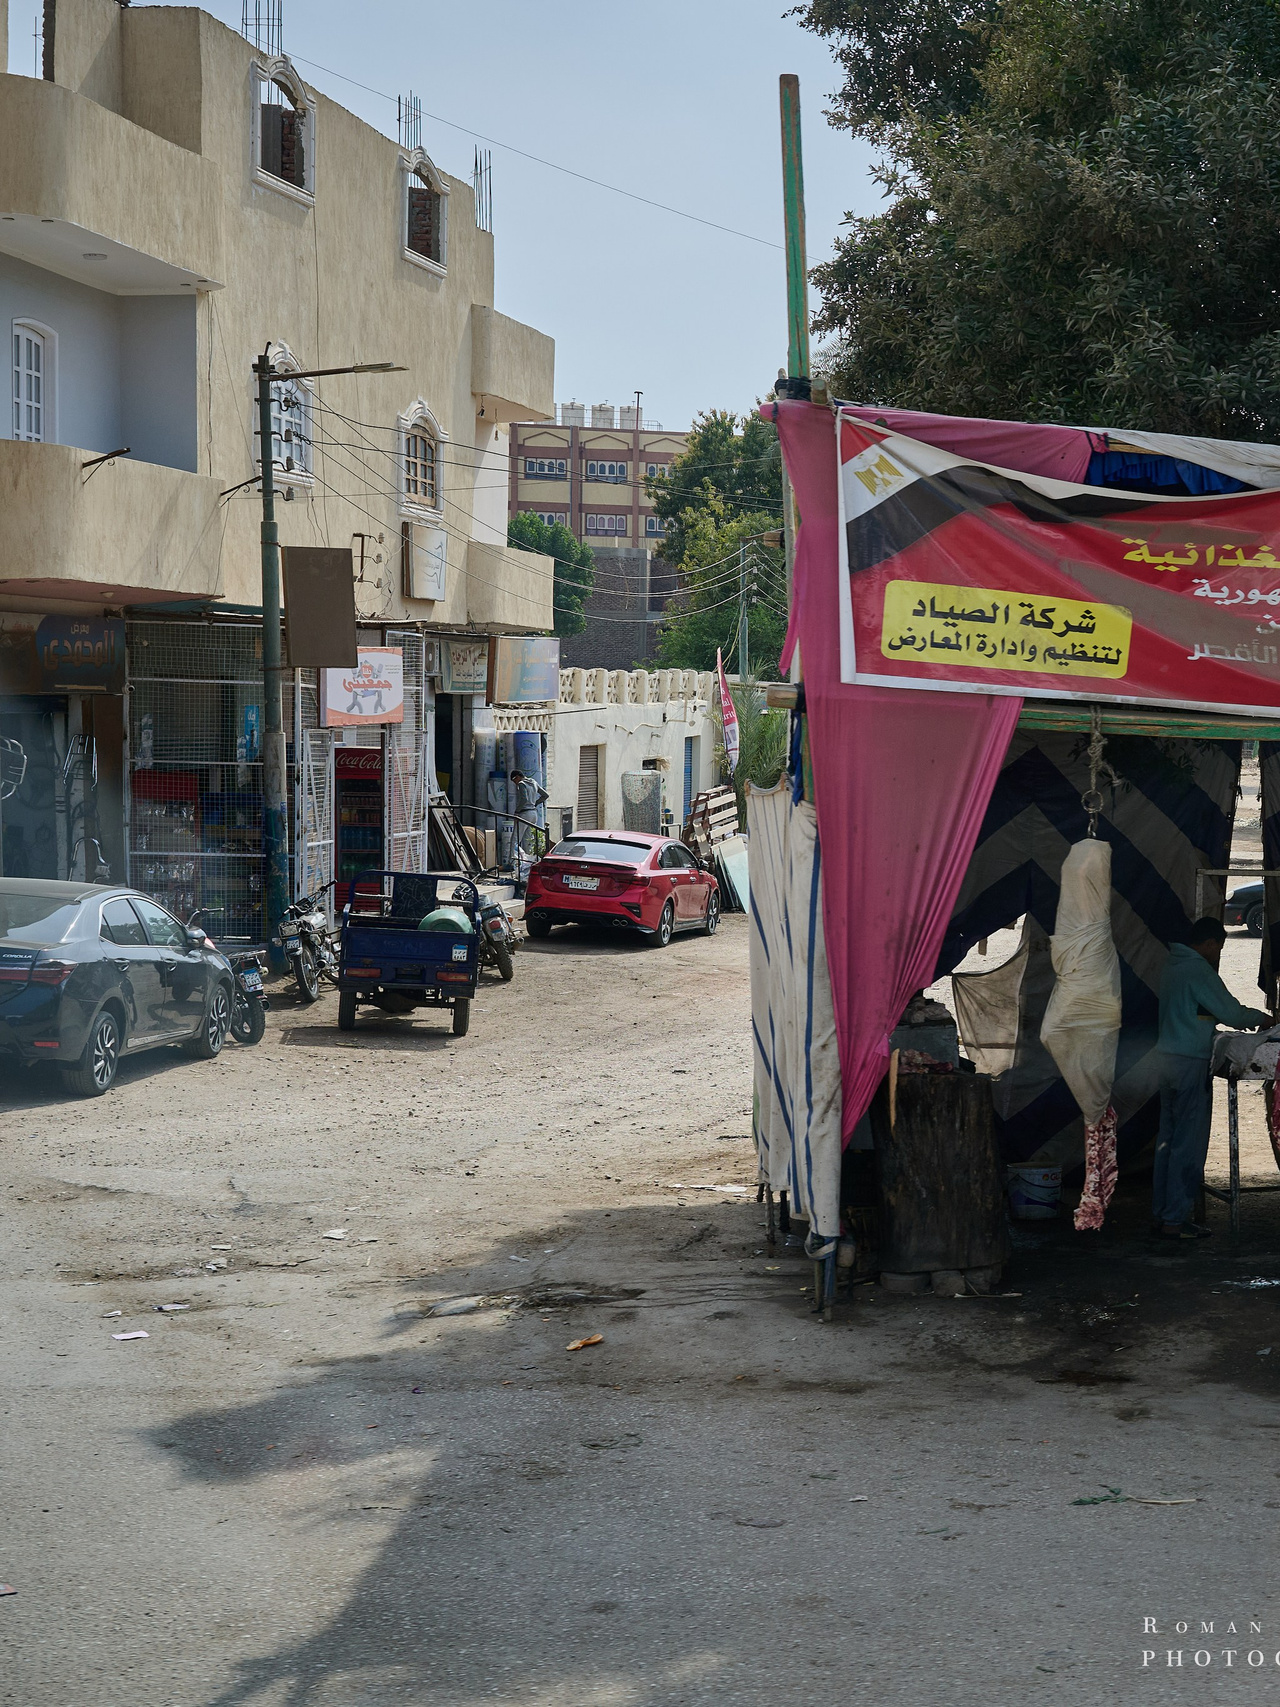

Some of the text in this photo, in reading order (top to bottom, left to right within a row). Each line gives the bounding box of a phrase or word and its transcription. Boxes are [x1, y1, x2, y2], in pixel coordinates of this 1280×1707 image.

[912, 596, 1096, 638] شركة الصياد
[888, 627, 1122, 667] لتنظيم وادارة المعارض
[1187, 639, 1277, 663] الأقصر
